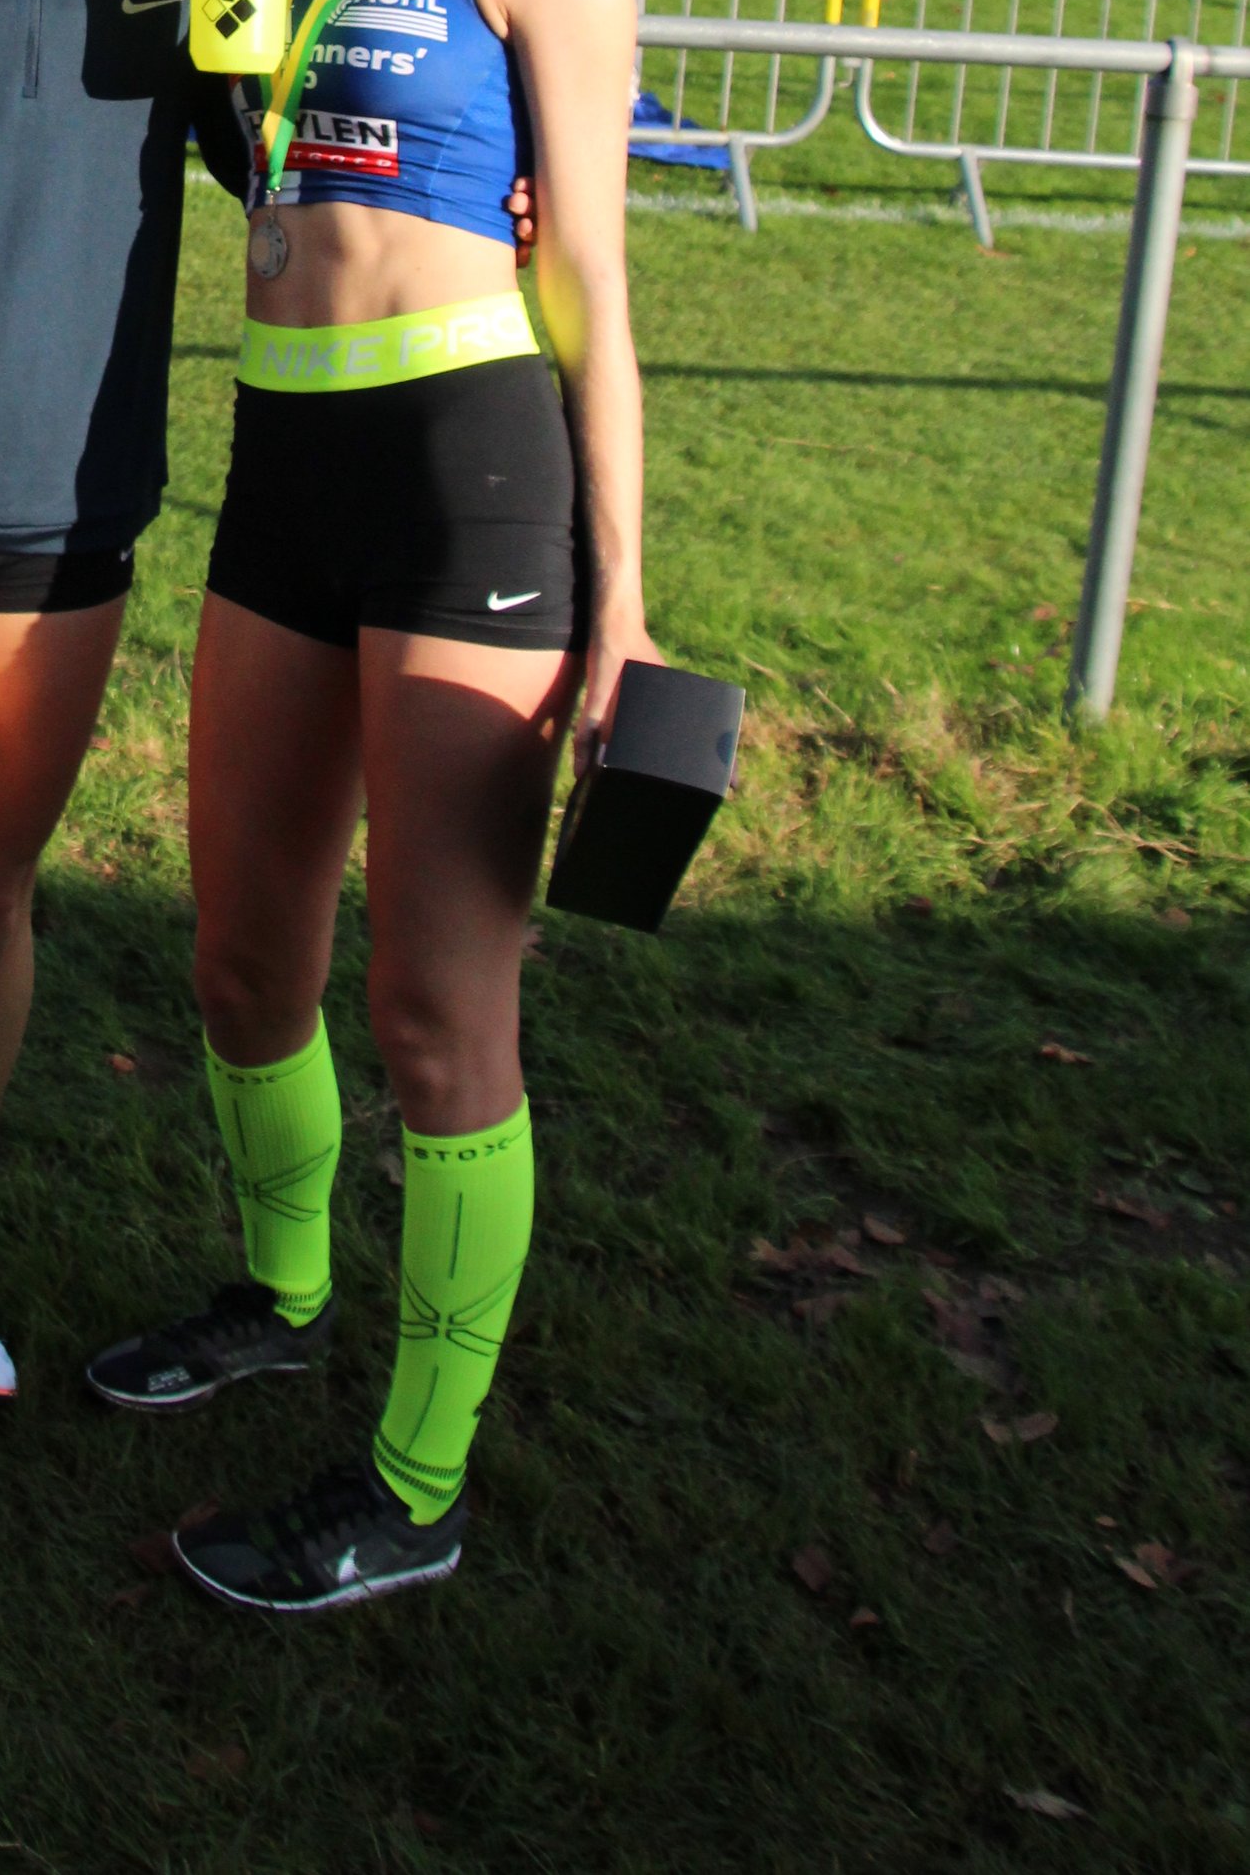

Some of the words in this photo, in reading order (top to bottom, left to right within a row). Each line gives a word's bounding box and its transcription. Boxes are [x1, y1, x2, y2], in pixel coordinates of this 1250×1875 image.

[308, 42, 428, 76] nners'
[248, 111, 391, 148] HYLEN
[259, 335, 385, 380] NIKE
